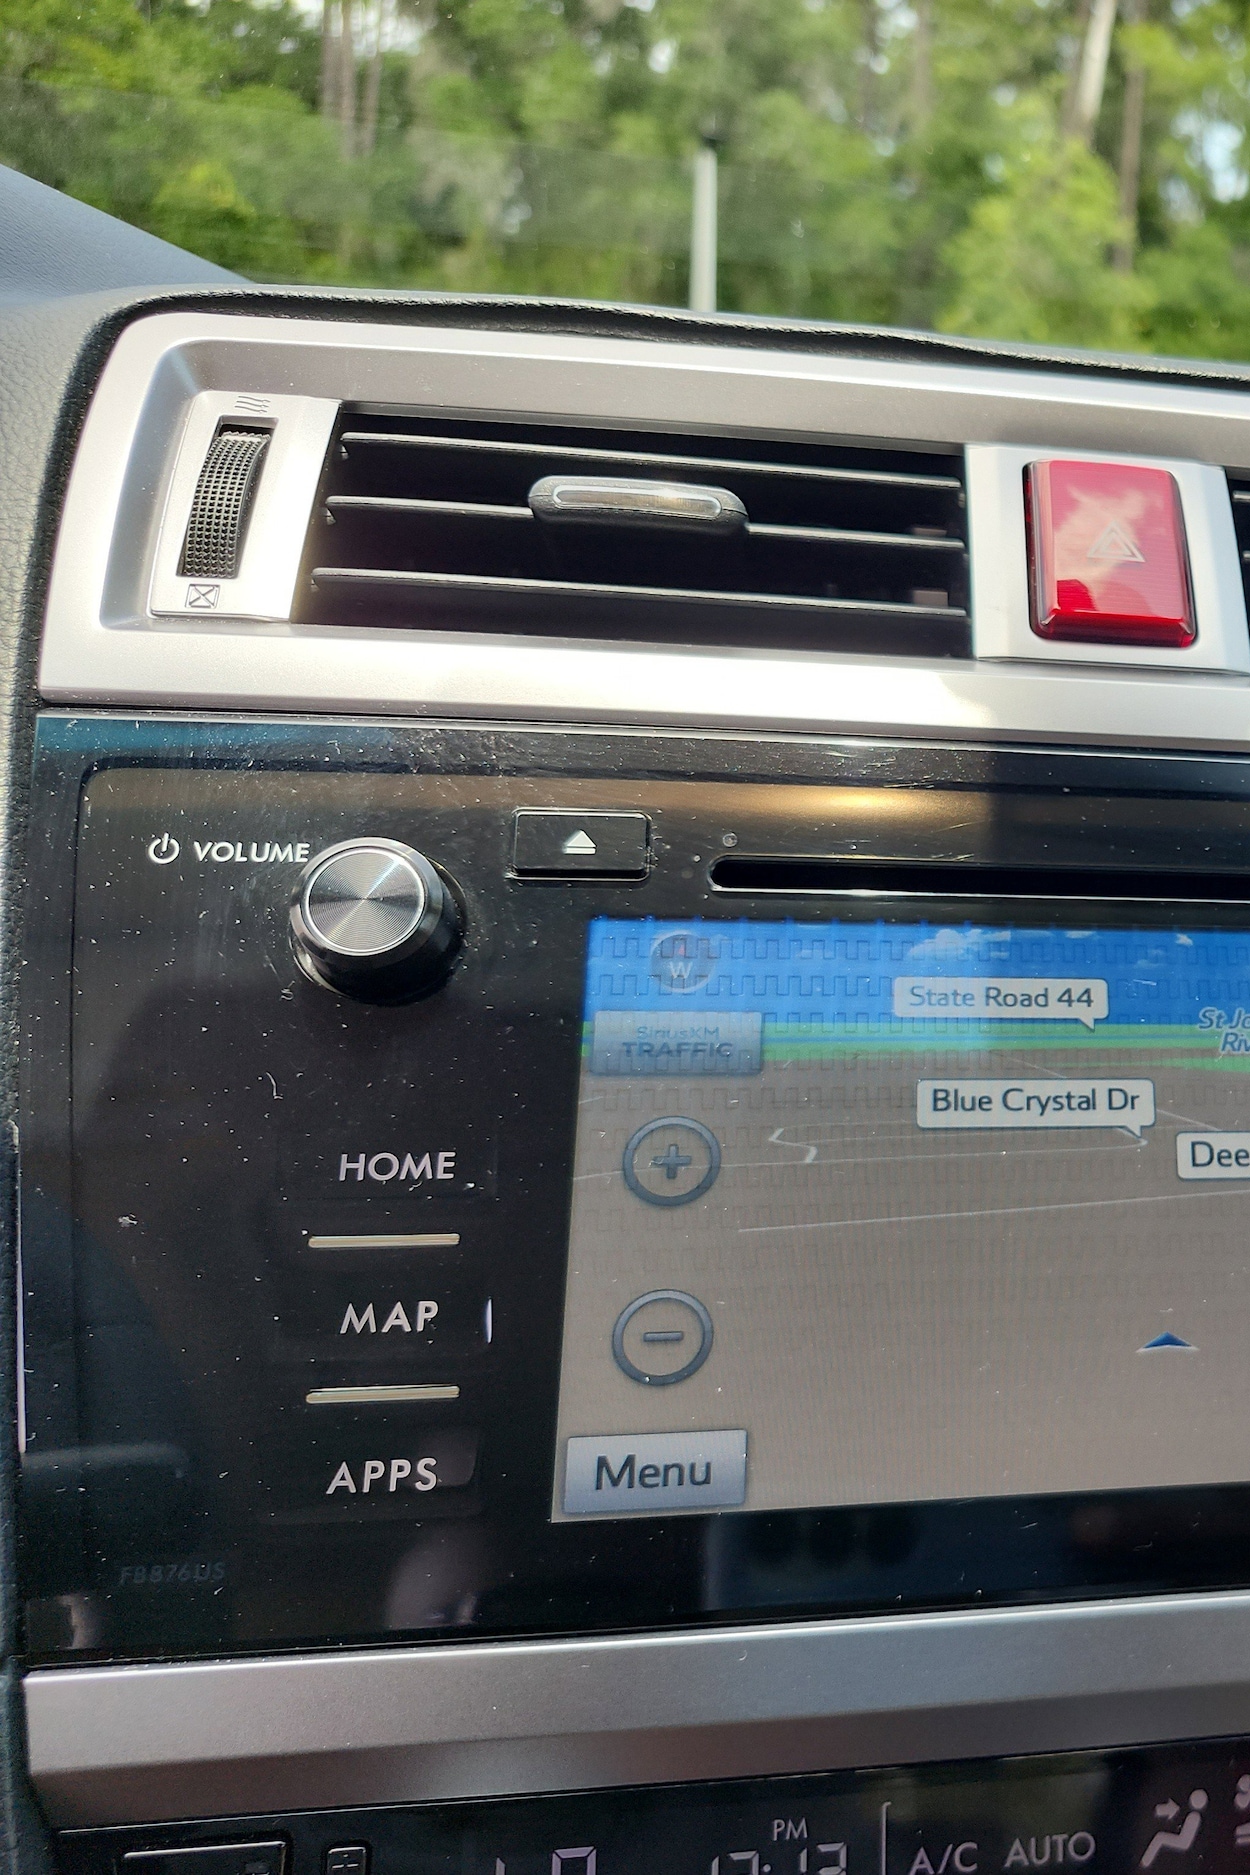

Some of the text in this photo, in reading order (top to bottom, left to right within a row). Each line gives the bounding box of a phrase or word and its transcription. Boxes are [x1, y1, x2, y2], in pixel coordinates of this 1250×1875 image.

[194, 840, 310, 864] VOLUME
[669, 961, 694, 979] W
[910, 986, 1095, 1009] State Road 44
[1199, 1008, 1224, 1030] St
[622, 1042, 733, 1058] TRAFFIC
[931, 1089, 1140, 1116] Blue Crystal Dr
[338, 1151, 456, 1183] HOME
[339, 1301, 440, 1335] MAP
[326, 1458, 438, 1495] APPS
[595, 1456, 714, 1491] Menu
[772, 1817, 808, 1841] PM
[908, 1842, 978, 1875] A/C
[1004, 1832, 1096, 1867] AUTO
